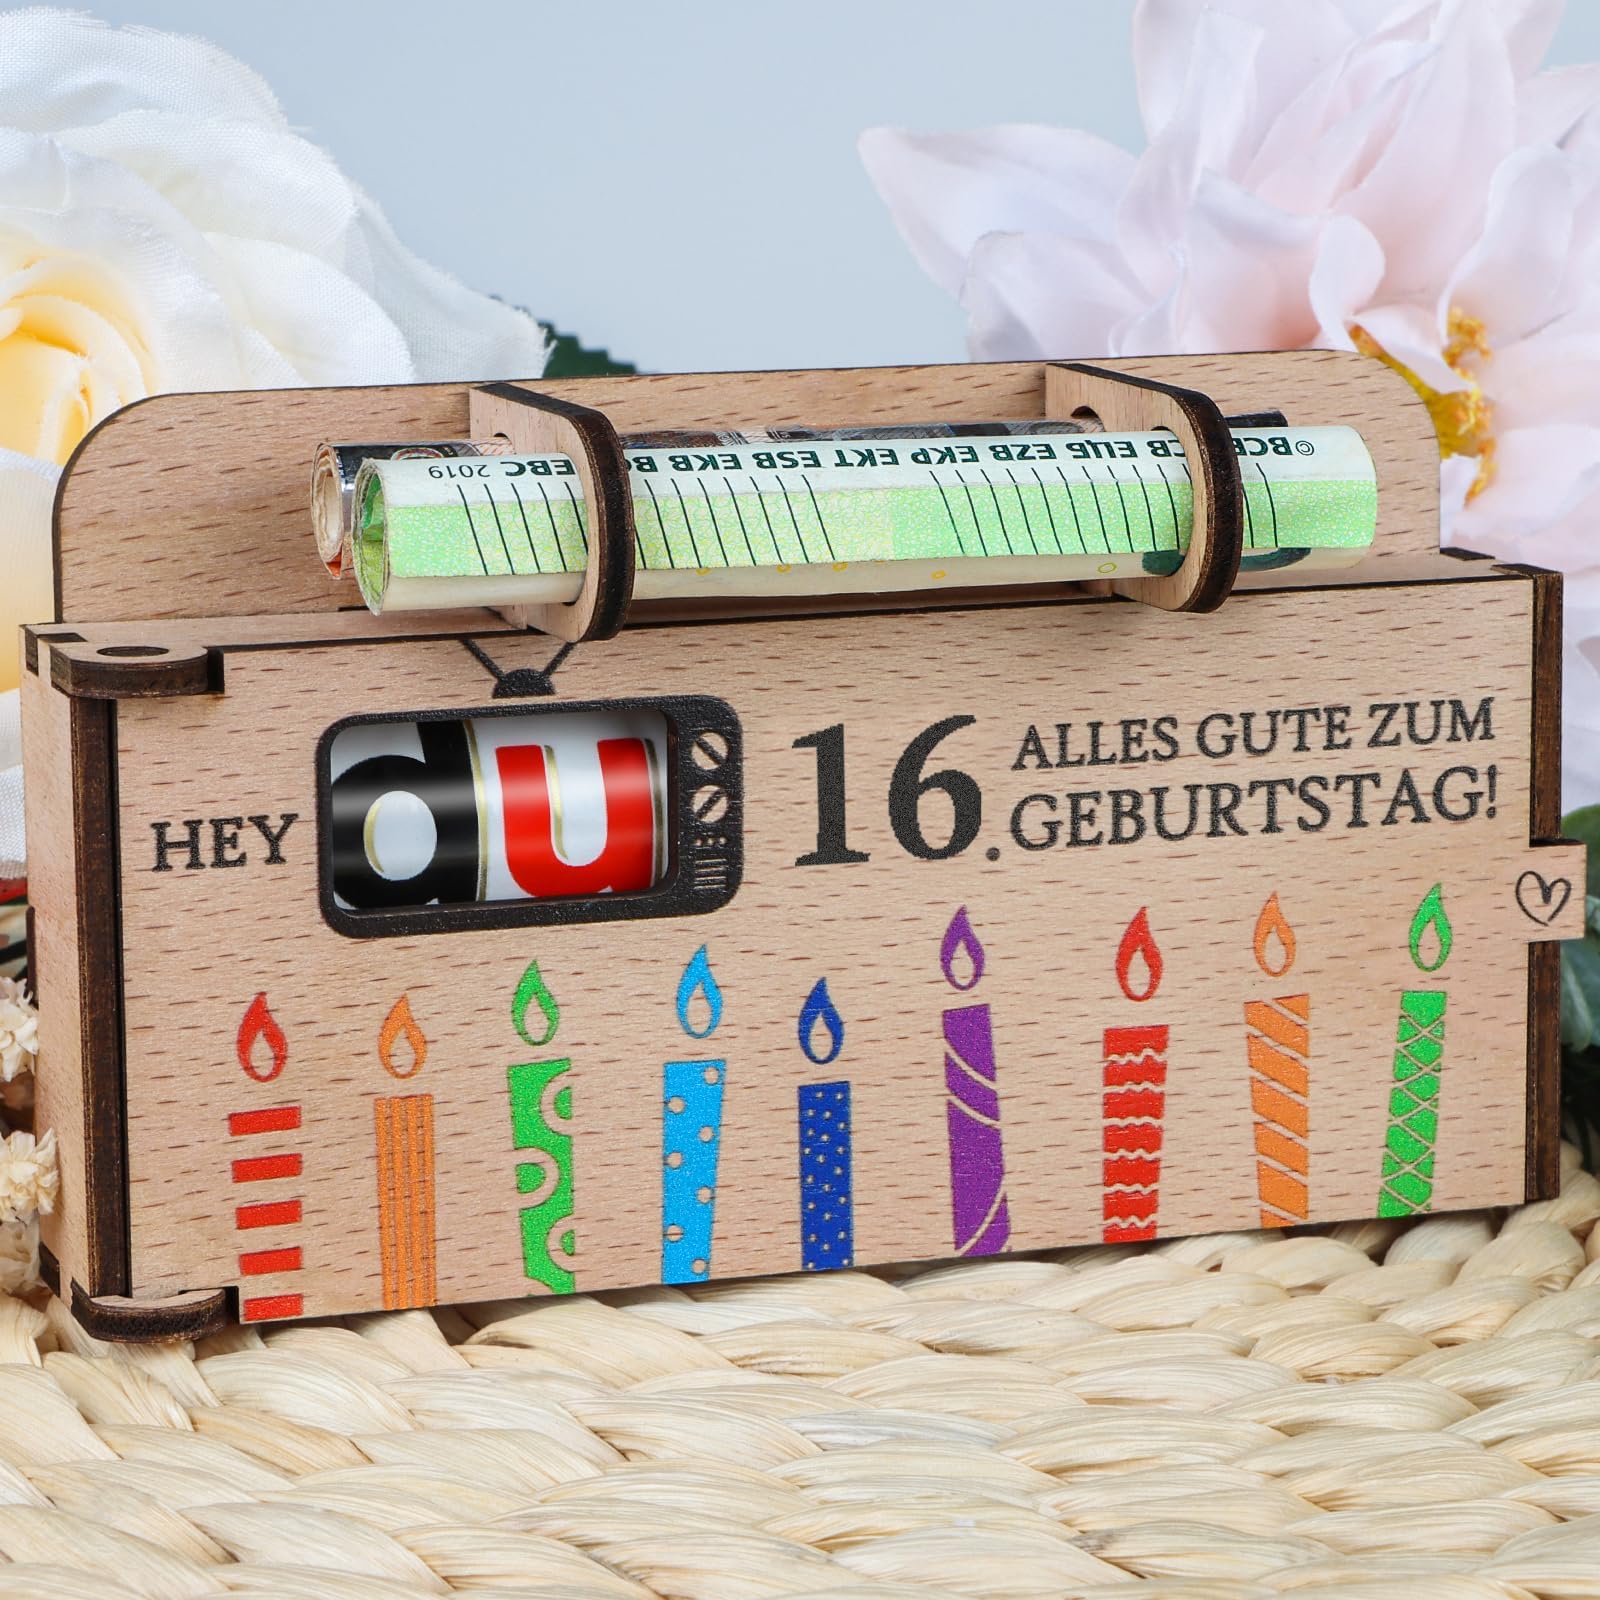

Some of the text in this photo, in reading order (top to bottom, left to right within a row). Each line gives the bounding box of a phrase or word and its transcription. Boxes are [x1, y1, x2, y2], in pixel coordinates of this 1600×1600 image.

[752, 450, 822, 469] ESB
[834, 448, 900, 467] EKT
[911, 445, 980, 465] EKP
[988, 442, 1057, 461] EZB
[429, 464, 491, 479] 2019
[500, 458, 576, 477] EBC
[668, 453, 743, 472] EKB
[1011, 696, 1495, 771] ALLES GUTE ZUM
[792, 714, 1000, 867] 16.
[1010, 764, 1499, 852] GEBURTSTAG!
[151, 813, 300, 872] HEY
